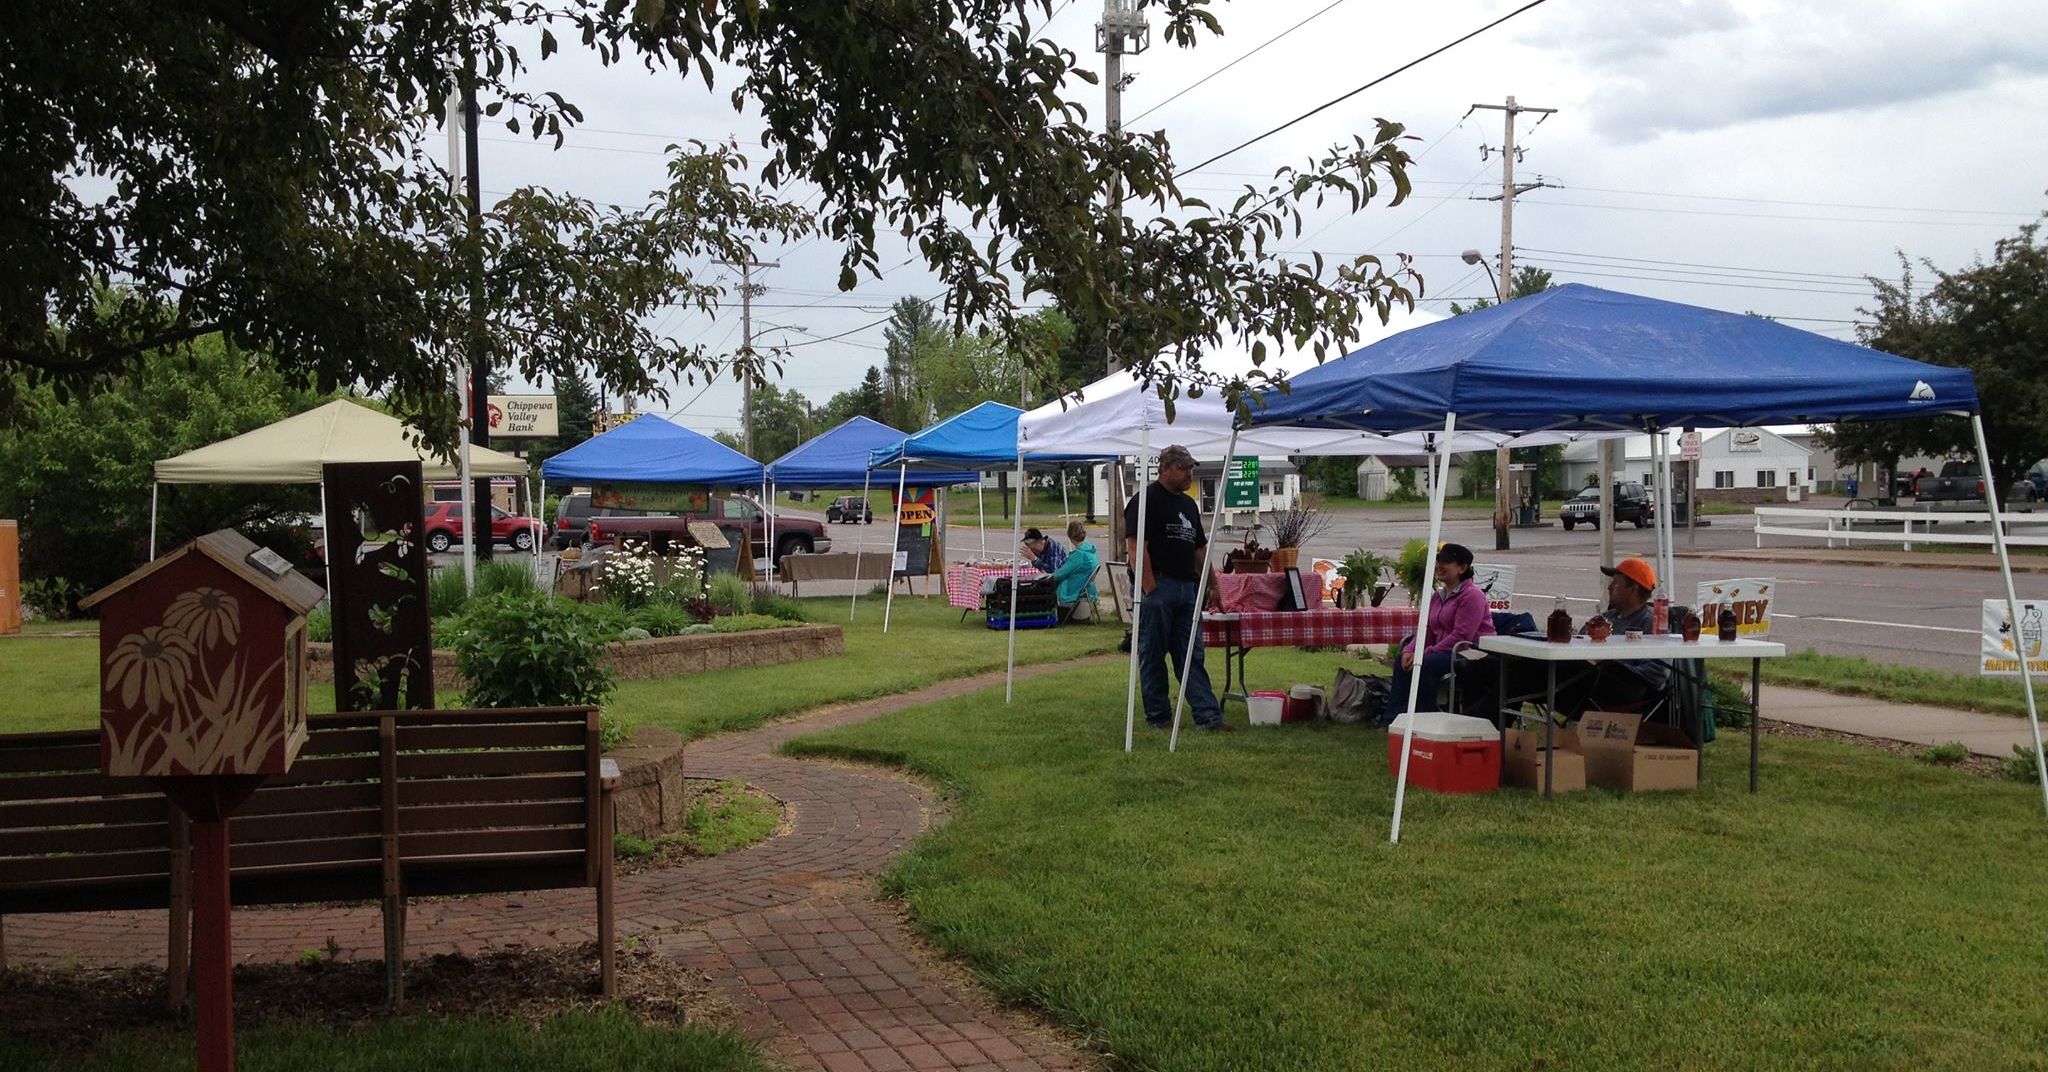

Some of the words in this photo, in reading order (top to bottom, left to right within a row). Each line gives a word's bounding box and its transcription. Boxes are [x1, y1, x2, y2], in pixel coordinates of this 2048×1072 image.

[507, 401, 553, 411] Chippewa
[507, 412, 538, 422] Valley
[507, 423, 534, 432] Bank
[899, 510, 932, 520] OPEN
[1488, 600, 1510, 610] GGS
[1702, 599, 1769, 628] HNEY
